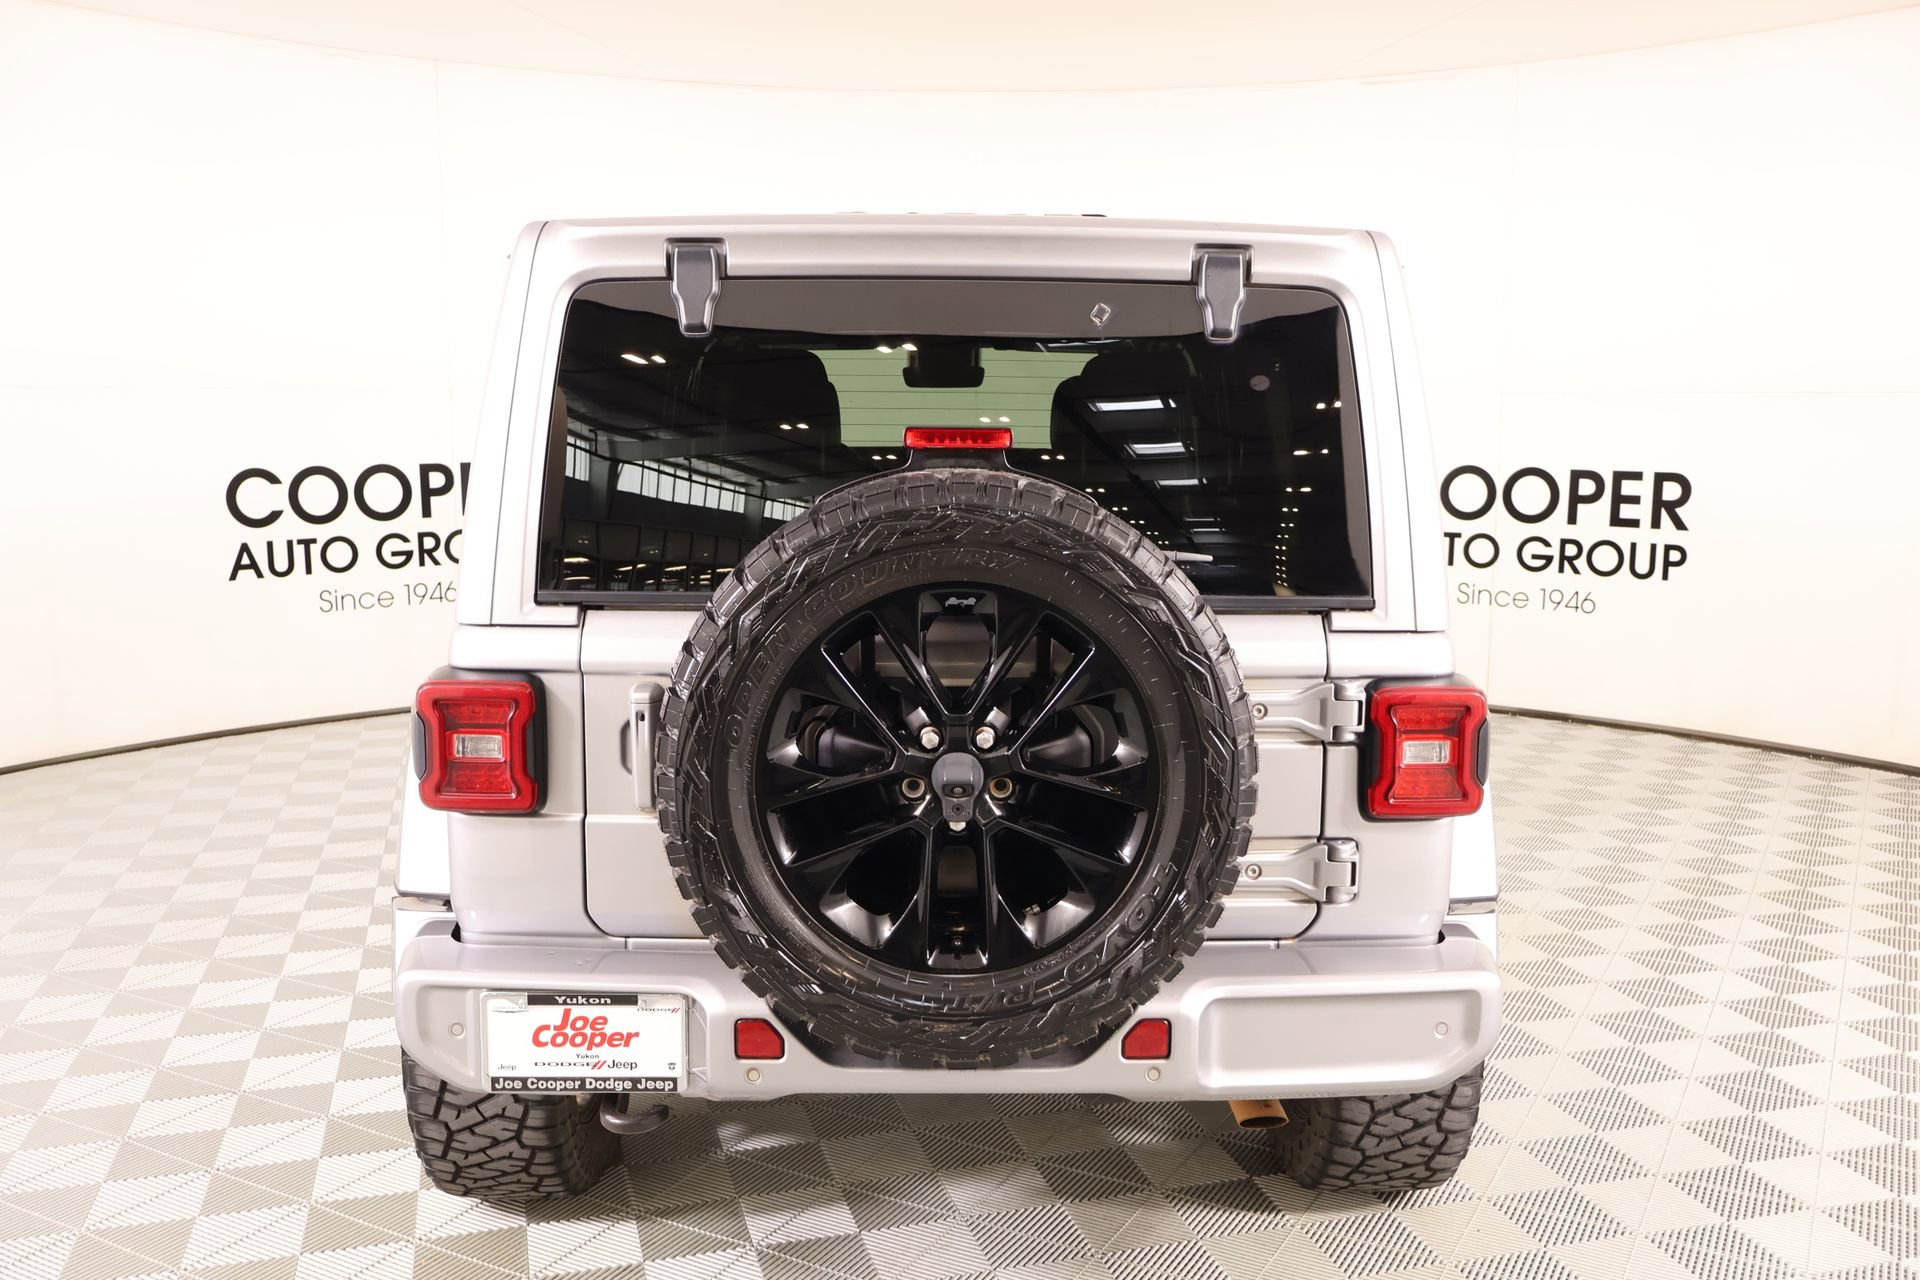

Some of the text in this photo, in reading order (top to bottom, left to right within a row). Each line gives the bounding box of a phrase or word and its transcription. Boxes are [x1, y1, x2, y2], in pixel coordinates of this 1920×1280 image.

[1440, 465, 1692, 531] OOPER
[229, 536, 358, 581] AUTO
[1444, 532, 1687, 581] TO GROUP
[319, 588, 395, 613] Since
[1456, 582, 1597, 615] Since 1946
[554, 995, 612, 1005] Yukon
[553, 1008, 609, 1032] Joe
[532, 1024, 640, 1051] Cooper
[497, 1063, 517, 1071] Jeep
[607, 1059, 638, 1071] Jeep
[495, 1077, 674, 1091] Joe Cooper Dodge Jeep
